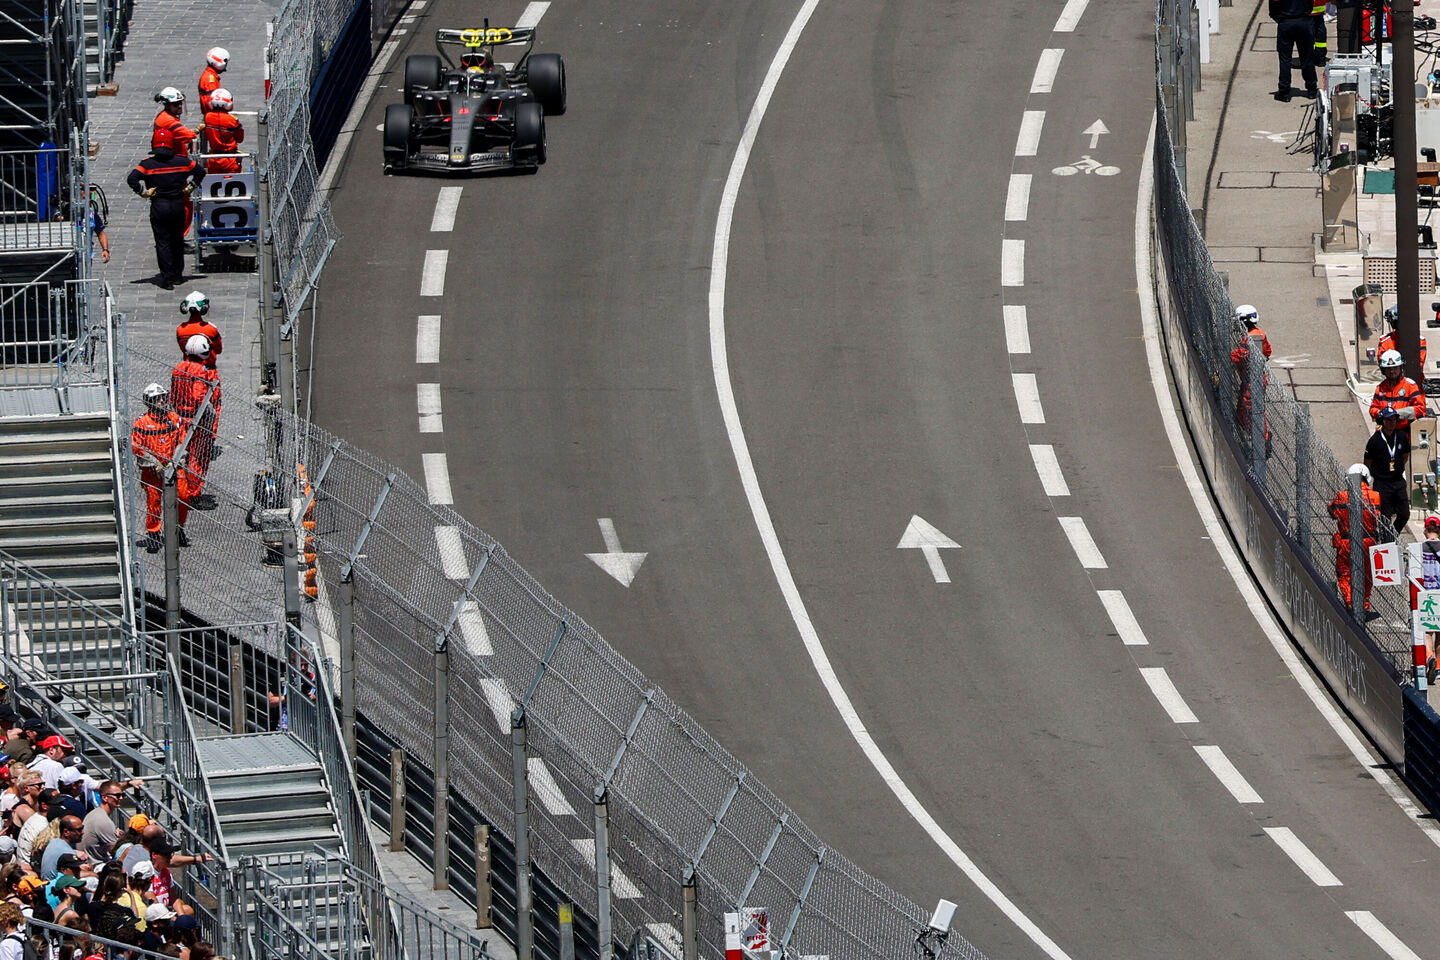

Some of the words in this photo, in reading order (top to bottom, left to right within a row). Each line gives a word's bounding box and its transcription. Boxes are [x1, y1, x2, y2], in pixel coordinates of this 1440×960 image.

[210, 180, 248, 229] SC
[1284, 558, 1322, 652] EXPLORA
[1321, 615, 1368, 706] JOURNEYS
